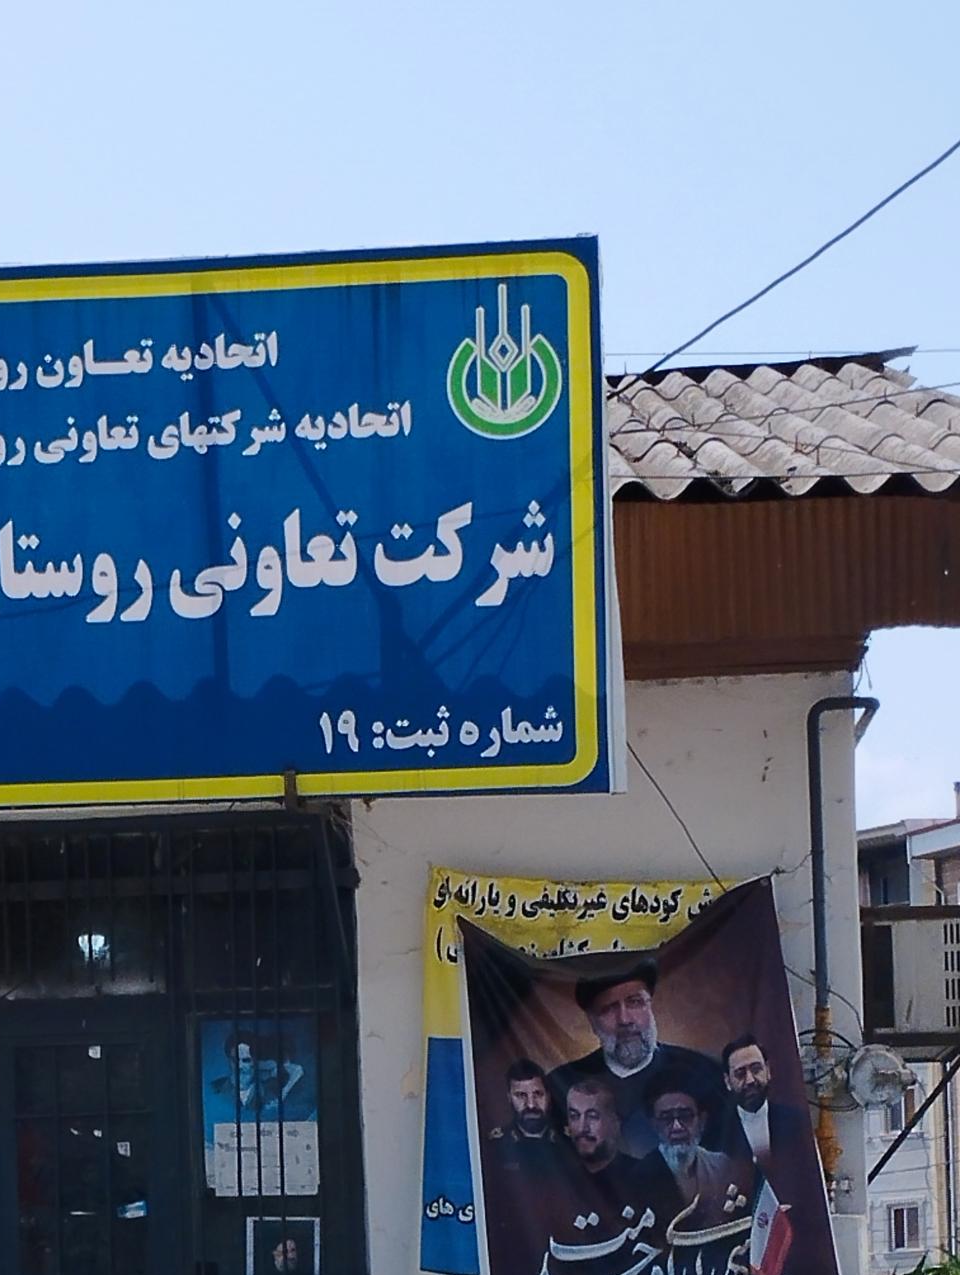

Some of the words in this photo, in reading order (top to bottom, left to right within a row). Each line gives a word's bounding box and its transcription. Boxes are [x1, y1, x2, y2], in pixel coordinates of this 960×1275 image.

[36, 339, 153, 388] تعاون
[161, 331, 278, 381] اتحادیه
[34, 416, 139, 464] تعاونی
[148, 409, 286, 460] شرکتهای
[294, 401, 412, 449] اتحادیه
[169, 509, 358, 619] تعاونی
[374, 500, 556, 606] شرکت
[319, 710, 360, 755] ۱۹
[371, 705, 451, 758] ثبت:
[459, 706, 563, 758] شماره
[505, 894, 517, 918] و
[522, 883, 607, 920] غیرتکلیفی
[611, 886, 682, 923] کودهای
[426, 1196, 455, 1219] های
